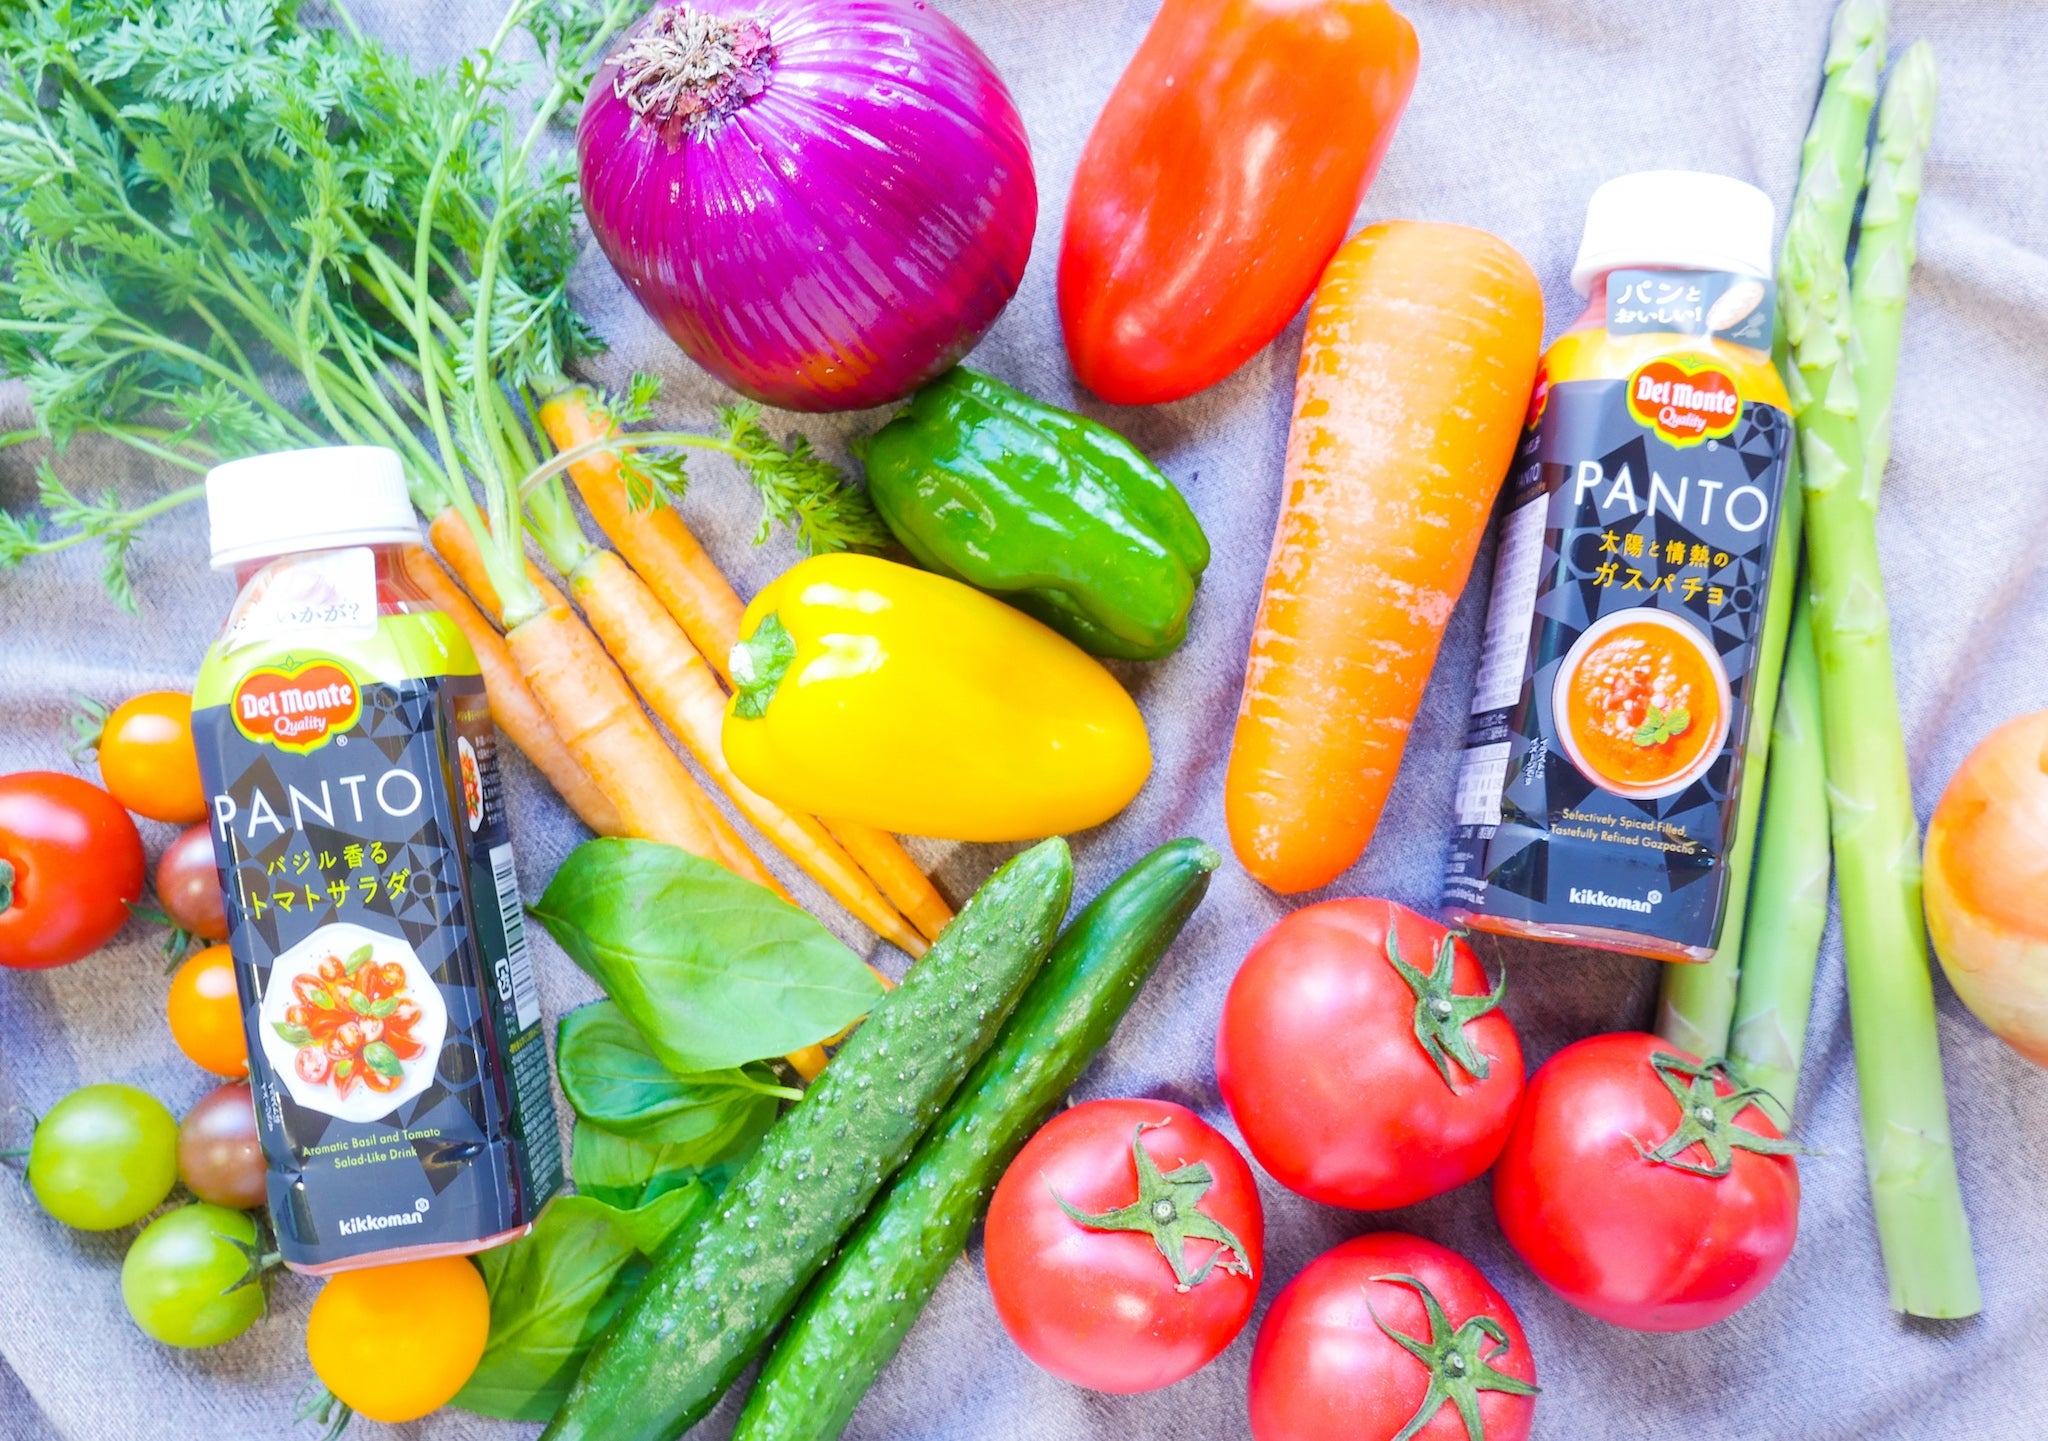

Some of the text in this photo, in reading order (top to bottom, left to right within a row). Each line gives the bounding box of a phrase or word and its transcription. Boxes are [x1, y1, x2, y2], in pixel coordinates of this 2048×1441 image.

[1616, 280, 1702, 305] パンと
[1636, 375, 1738, 415] Del Monte
[1657, 405, 1708, 433] Quality
[1573, 460, 1769, 533] PANTO
[1597, 530, 1730, 569] 太陽と情熱の
[1592, 561, 1725, 607] ガスパチョ
[241, 682, 353, 720] Del Monte
[273, 714, 327, 738] Quality
[213, 769, 423, 843] PANTO
[1561, 808, 1617, 828] Selectively
[1551, 824, 1695, 856] Tastefully Refined Gazpacho
[266, 839, 389, 877] バジル香る
[251, 869, 412, 920] トマトサラダ
[1569, 887, 1652, 914] kikkoman
[302, 1126, 441, 1158] Aromatic Basil and Tomato
[333, 1146, 418, 1169] Salad-Like Drink
[339, 1209, 423, 1237] kikkoman
